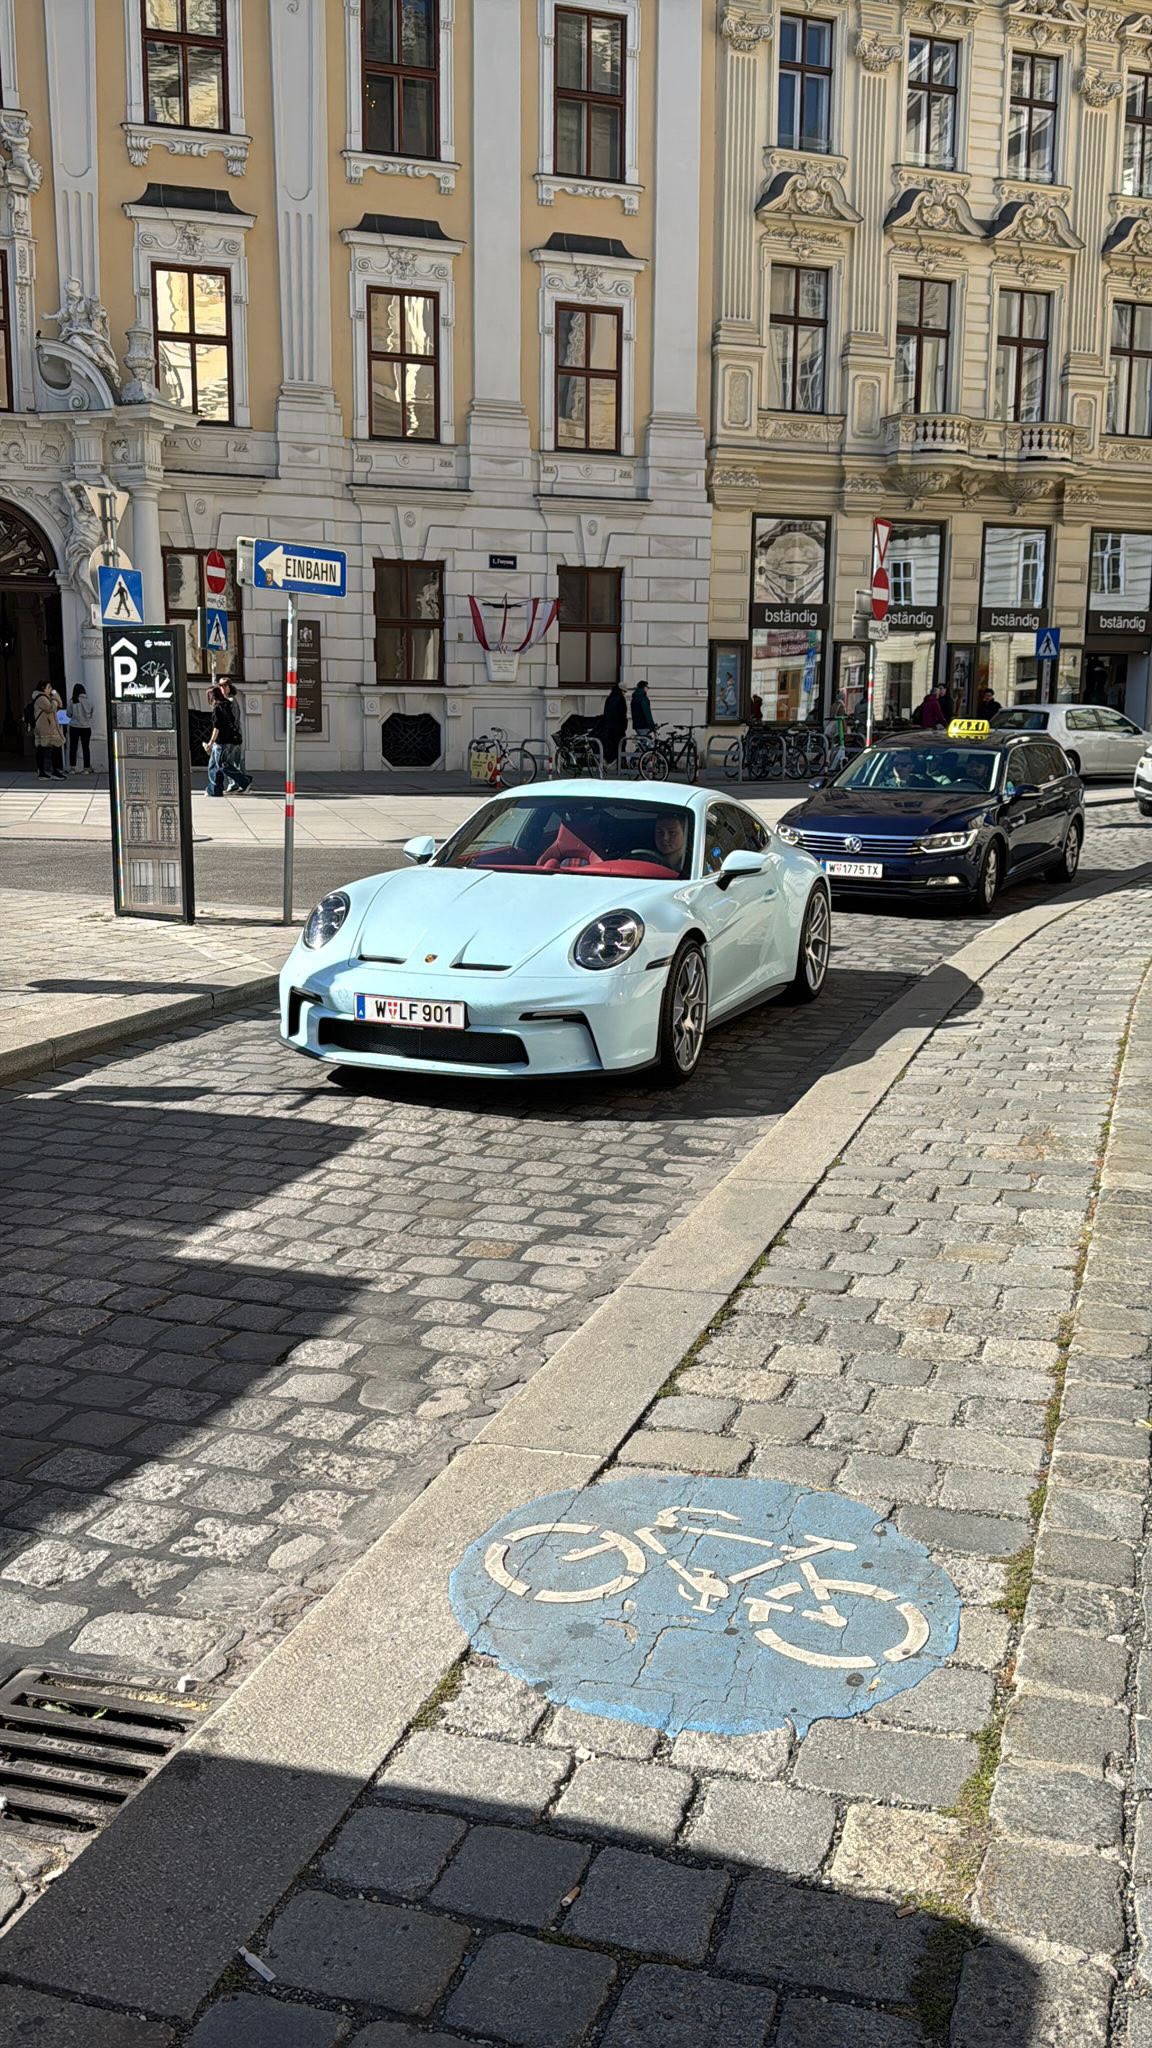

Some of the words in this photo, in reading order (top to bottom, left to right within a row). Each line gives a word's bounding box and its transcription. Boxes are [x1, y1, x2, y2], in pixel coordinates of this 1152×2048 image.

[285, 557, 337, 583] EINBAHN
[764, 608, 818, 627] bständig
[990, 613, 1040, 630] bständig
[1099, 615, 1146, 632] bständig
[113, 655, 138, 698] P
[843, 864, 865, 875] 1775
[867, 865, 879, 876] TX
[375, 1000, 387, 1018] W
[399, 1002, 419, 1021] LF
[422, 1004, 453, 1024] 901
